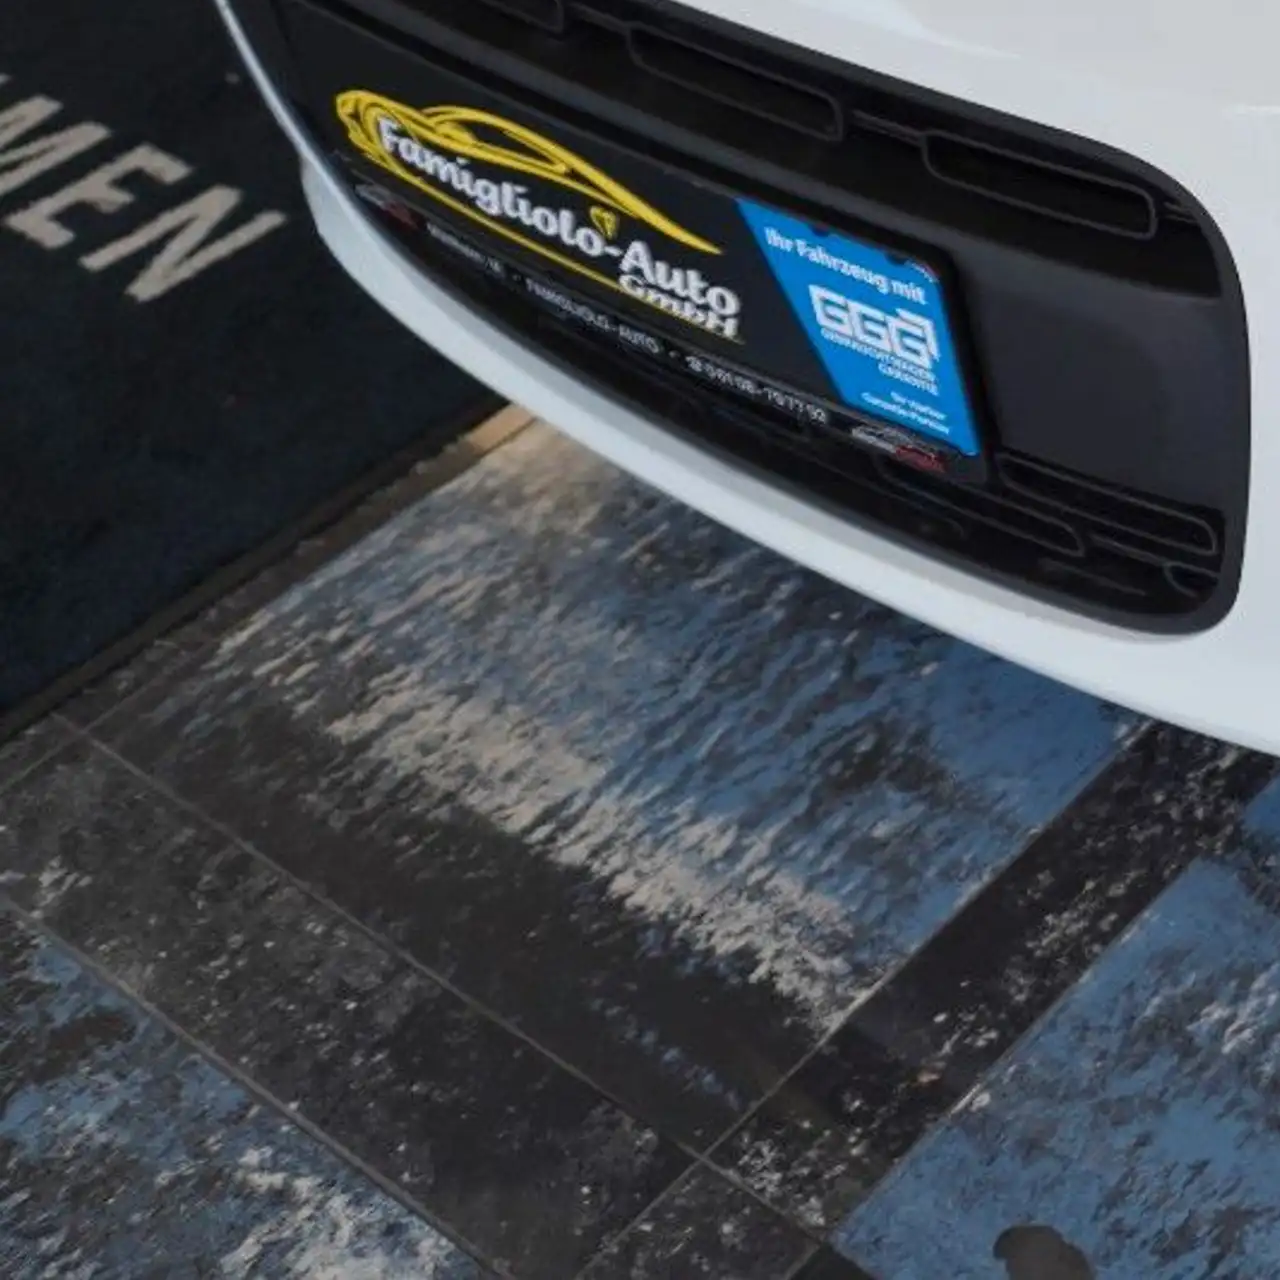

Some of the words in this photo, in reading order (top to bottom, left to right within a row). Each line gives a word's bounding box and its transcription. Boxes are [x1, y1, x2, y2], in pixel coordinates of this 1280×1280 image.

[377, 113, 742, 316] Famigliolo-Auto
[763, 226, 793, 253] Ihr
[796, 238, 890, 295] Fahrzeug
[891, 279, 928, 306] mit
[618, 274, 739, 339] GmbH
